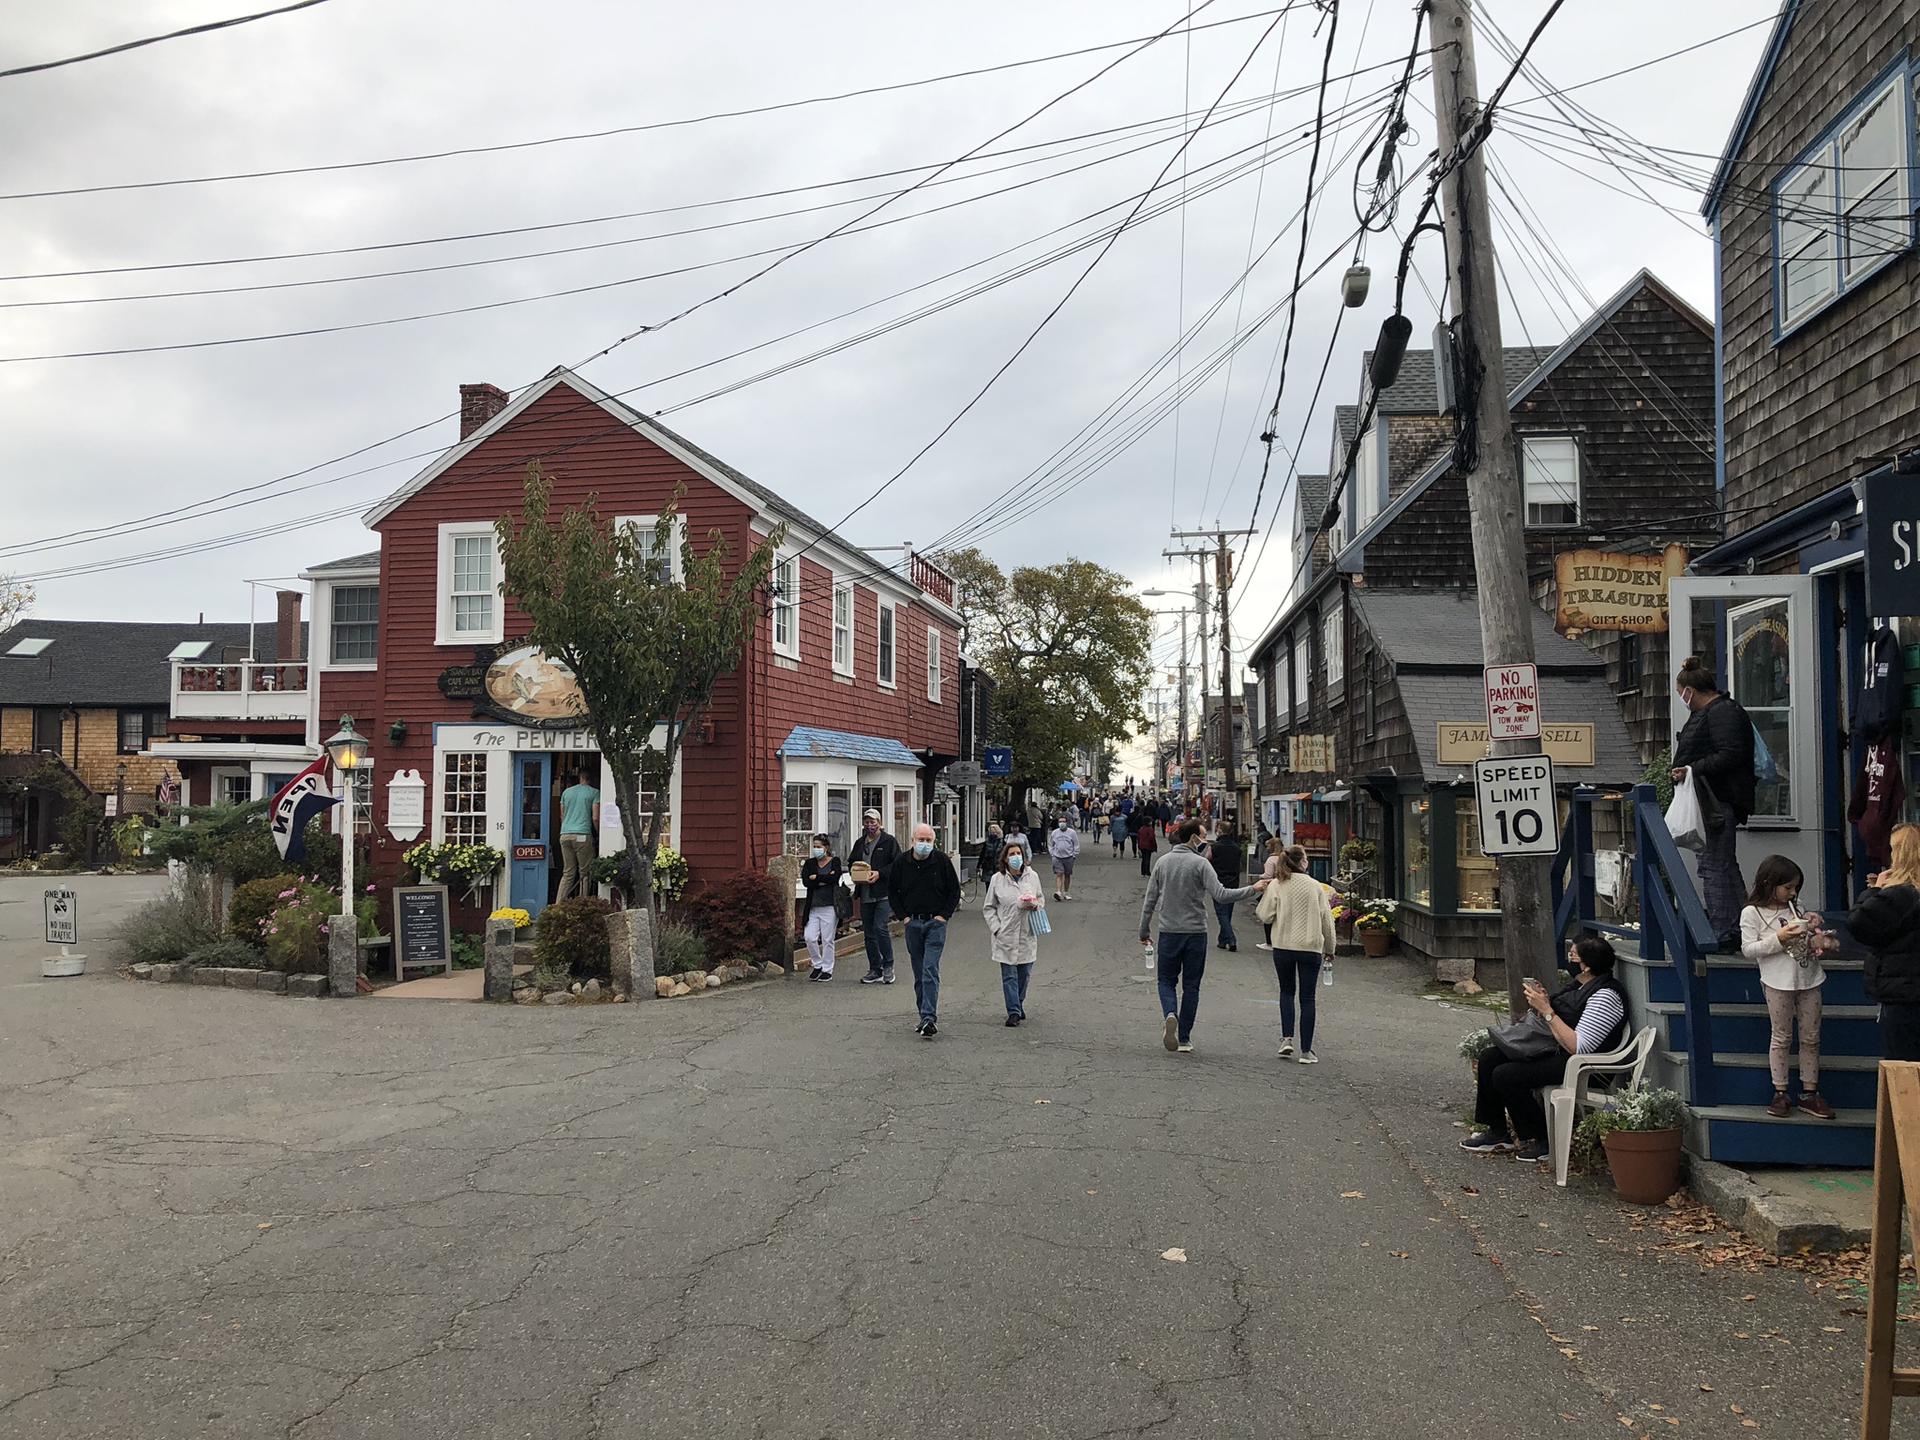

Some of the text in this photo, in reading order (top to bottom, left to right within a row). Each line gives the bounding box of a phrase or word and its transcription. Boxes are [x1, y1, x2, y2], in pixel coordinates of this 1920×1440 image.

[1573, 565, 1662, 586] HIDDEN
[1563, 588, 1669, 608] TREASURE
[1592, 615, 1653, 625] GIFT SHOP
[1501, 671, 1520, 686] NO
[1489, 685, 1535, 701] PARKING
[1498, 715, 1530, 725] TOW AWAY
[1505, 724, 1524, 733] ZONE
[473, 731, 600, 749] The PEWTER
[1303, 749, 1321, 758] ART
[1294, 758, 1329, 768] GALLERY
[1482, 766, 1546, 783] SPEED
[1490, 787, 1541, 803] LIMIT
[496, 822, 505, 831] 16
[1495, 808, 1543, 845] 10
[516, 847, 543, 857] OPEN
[44, 890, 75, 899] ONE WAY
[50, 921, 72, 930] NO THRU
[50, 930, 72, 940] TRAFFIC
